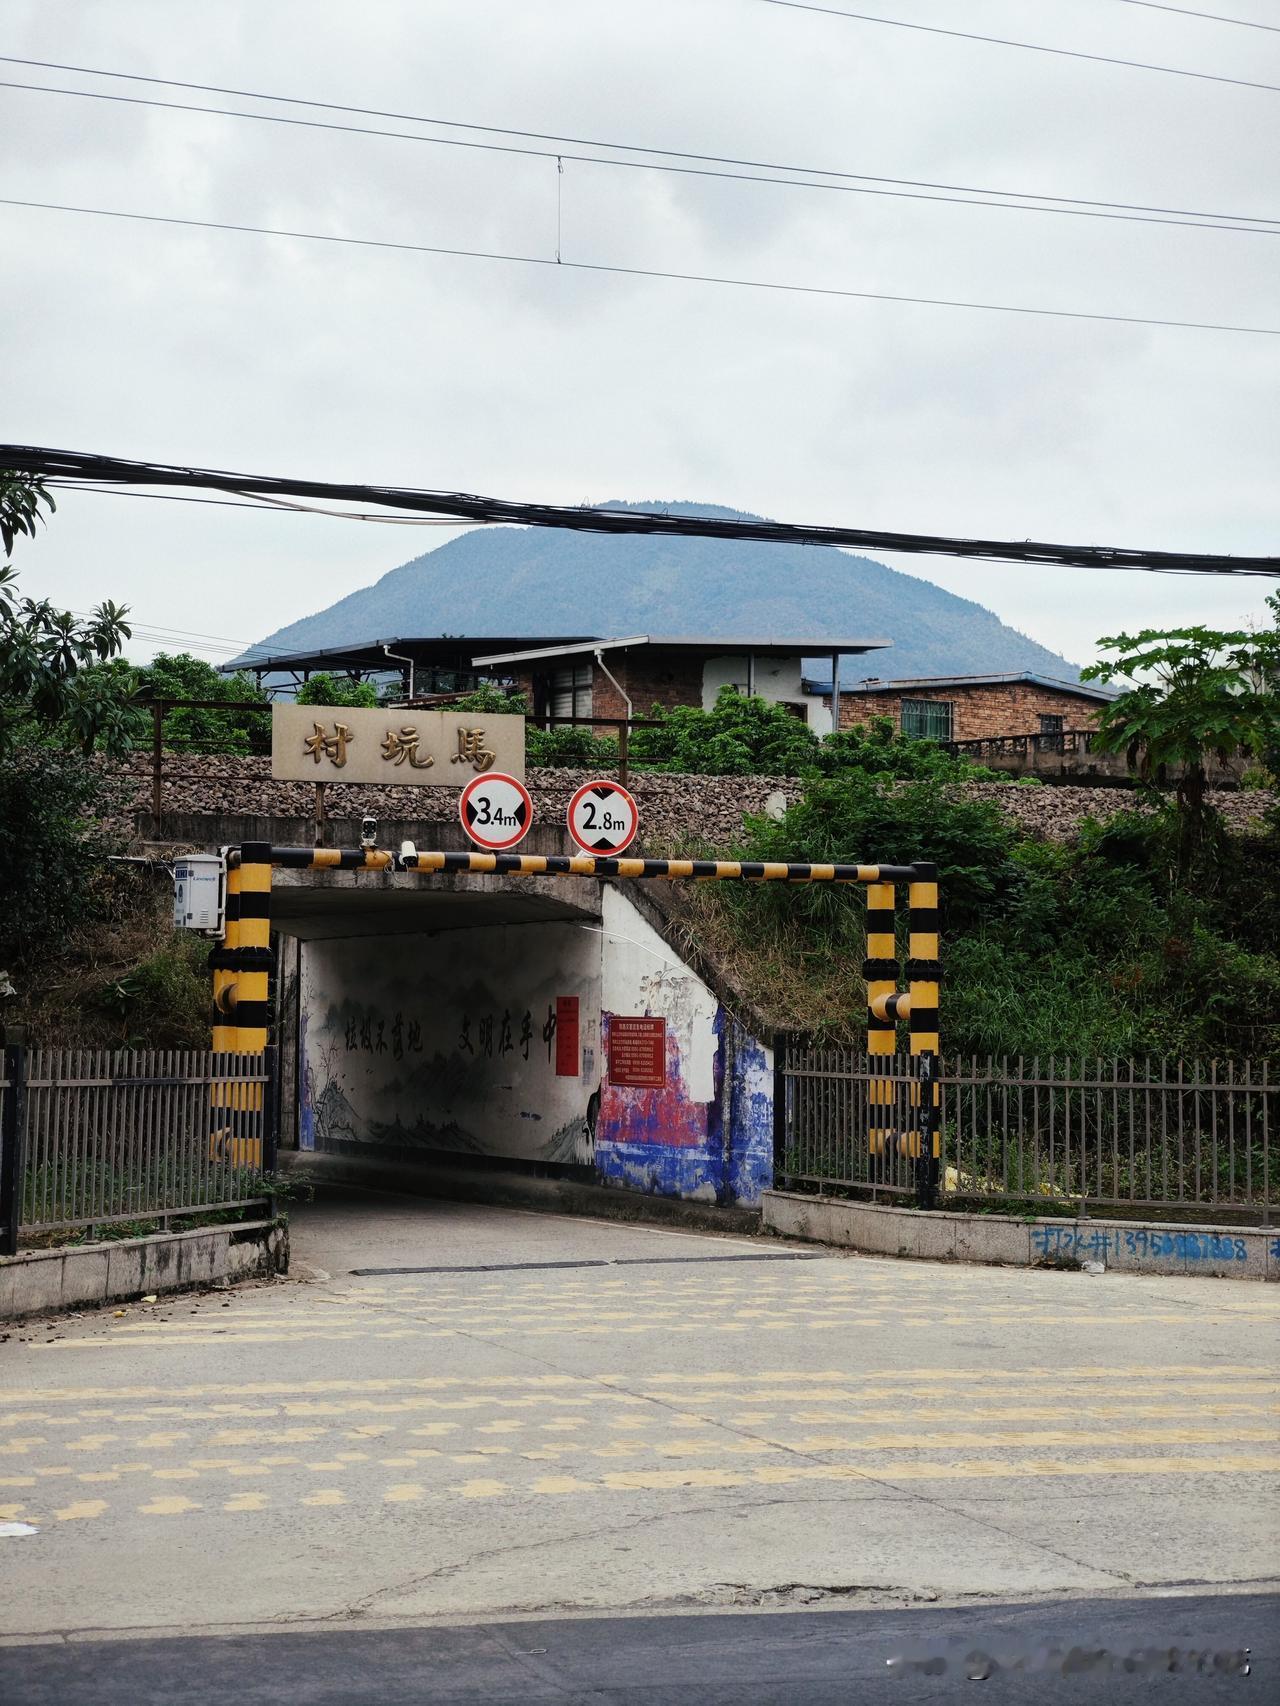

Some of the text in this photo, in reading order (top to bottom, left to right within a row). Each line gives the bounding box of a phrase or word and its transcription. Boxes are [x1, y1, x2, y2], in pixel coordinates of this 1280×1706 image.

[476, 796, 517, 827] 3.4m
[582, 802, 625, 831] 2.8m
[457, 1004, 557, 1064] 文明在手中
